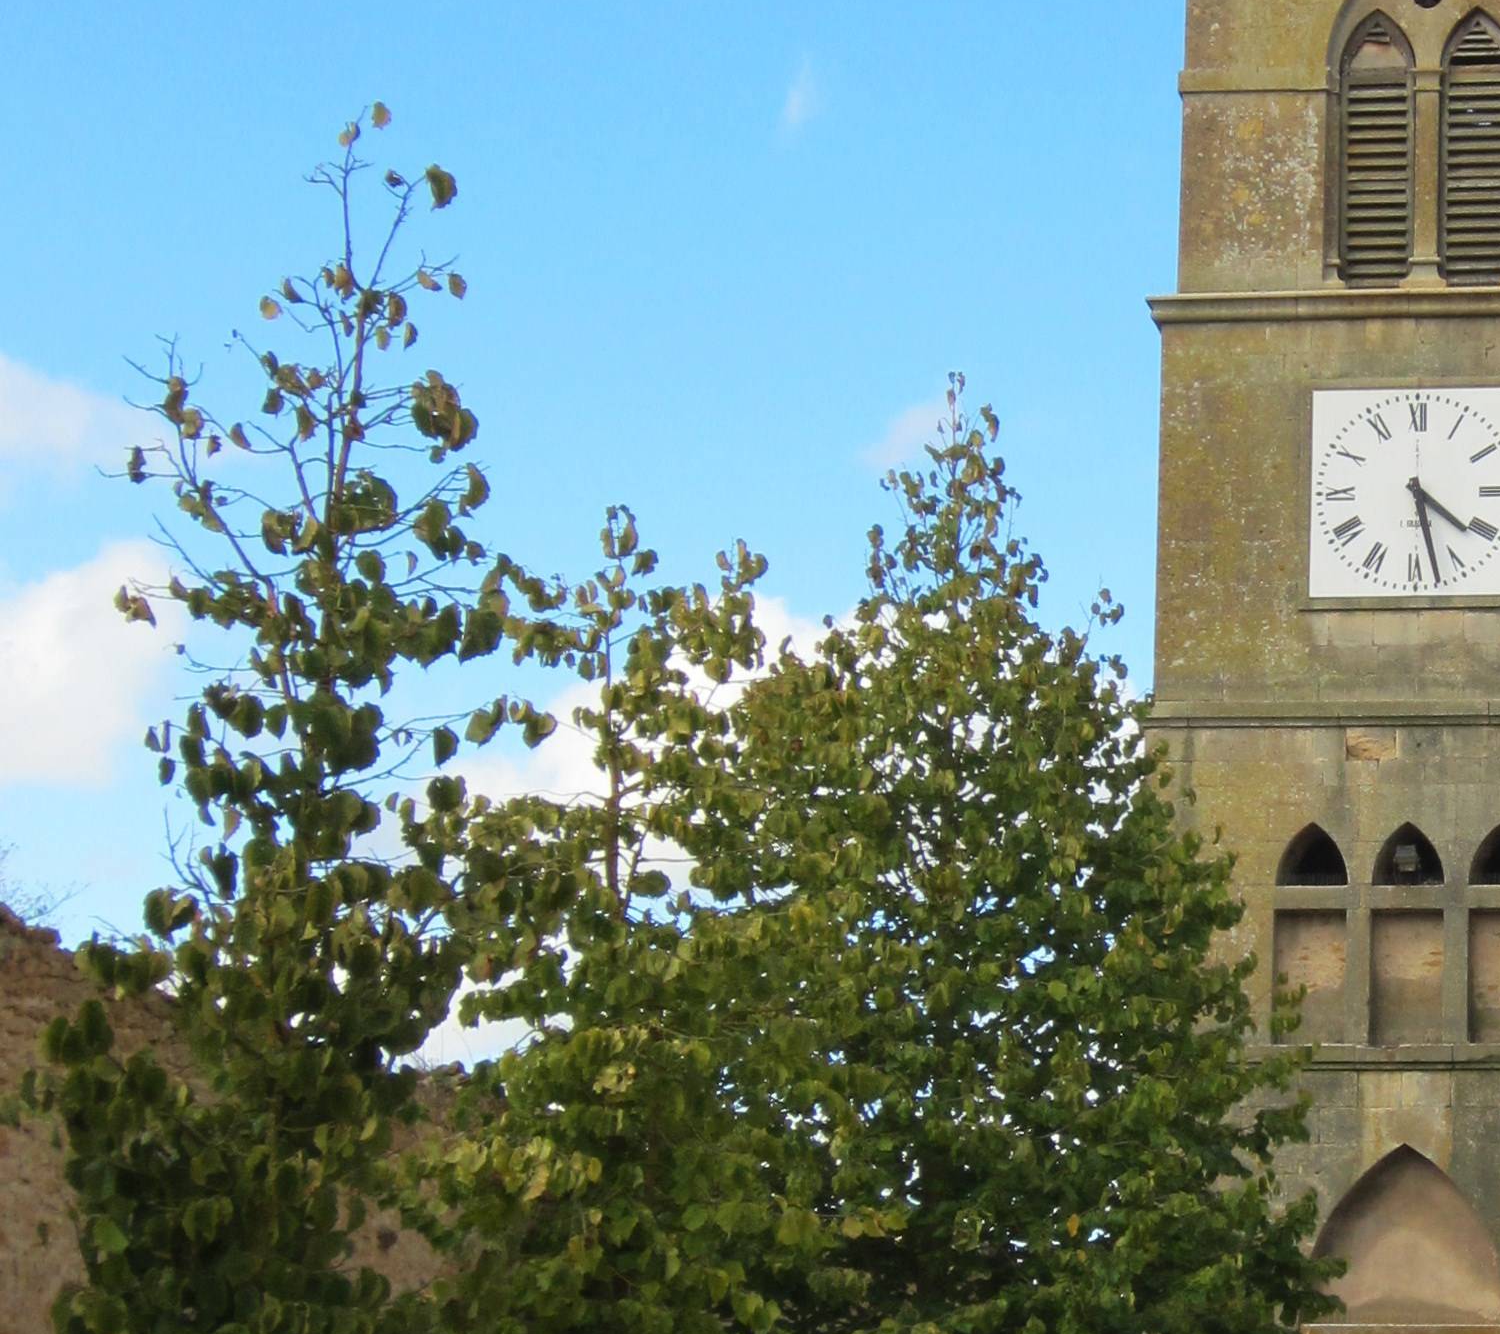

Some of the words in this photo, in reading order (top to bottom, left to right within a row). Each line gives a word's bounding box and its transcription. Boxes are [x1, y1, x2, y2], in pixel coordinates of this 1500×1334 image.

[1366, 412, 1392, 443] XI
[1408, 402, 1427, 432] XII
[1447, 414, 1465, 440] I
[1336, 445, 1366, 467] X
[1469, 443, 1497, 463] II
[1325, 486, 1355, 501] IX
[1332, 515, 1365, 547] VIII
[1362, 541, 1388, 574] VII
[1408, 553, 1422, 582] VI
[1446, 544, 1465, 572] V
